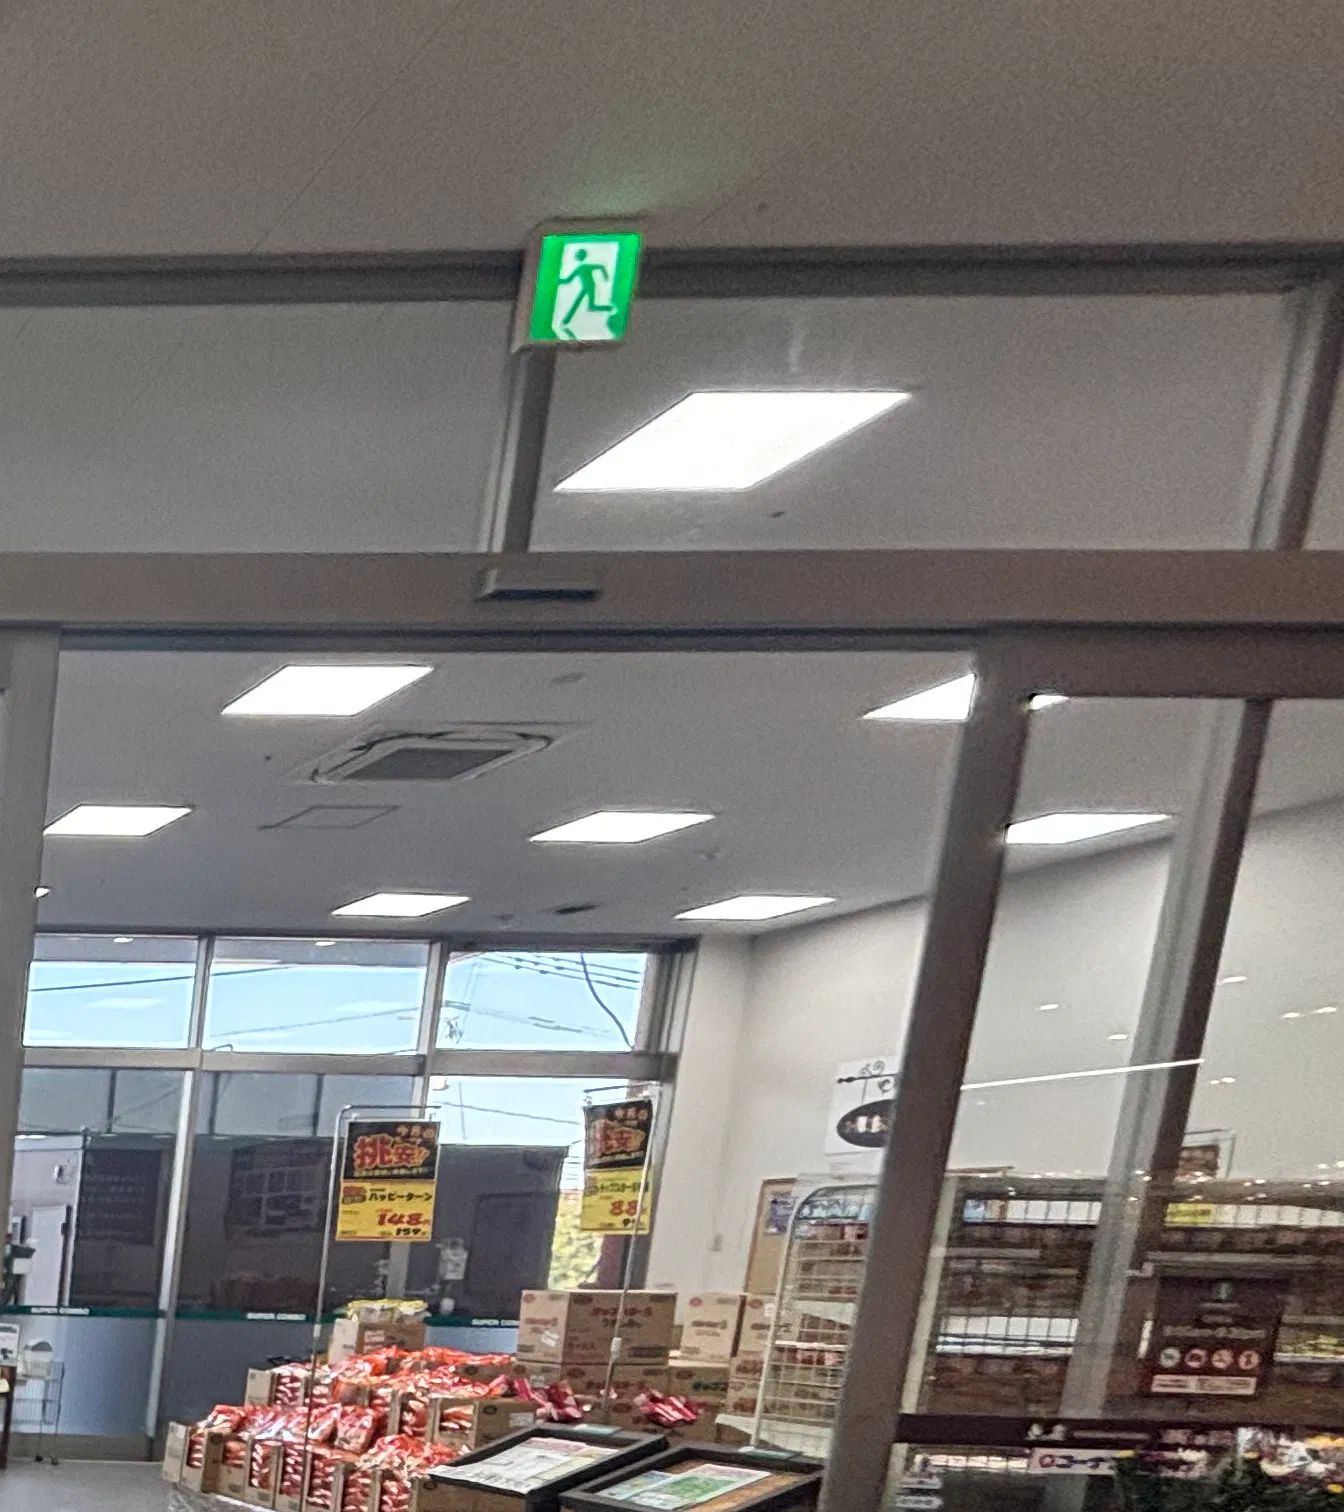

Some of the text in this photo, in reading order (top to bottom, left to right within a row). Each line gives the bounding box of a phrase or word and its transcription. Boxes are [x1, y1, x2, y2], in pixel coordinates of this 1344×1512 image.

[368, 1192, 432, 1202] ハッピーターン
